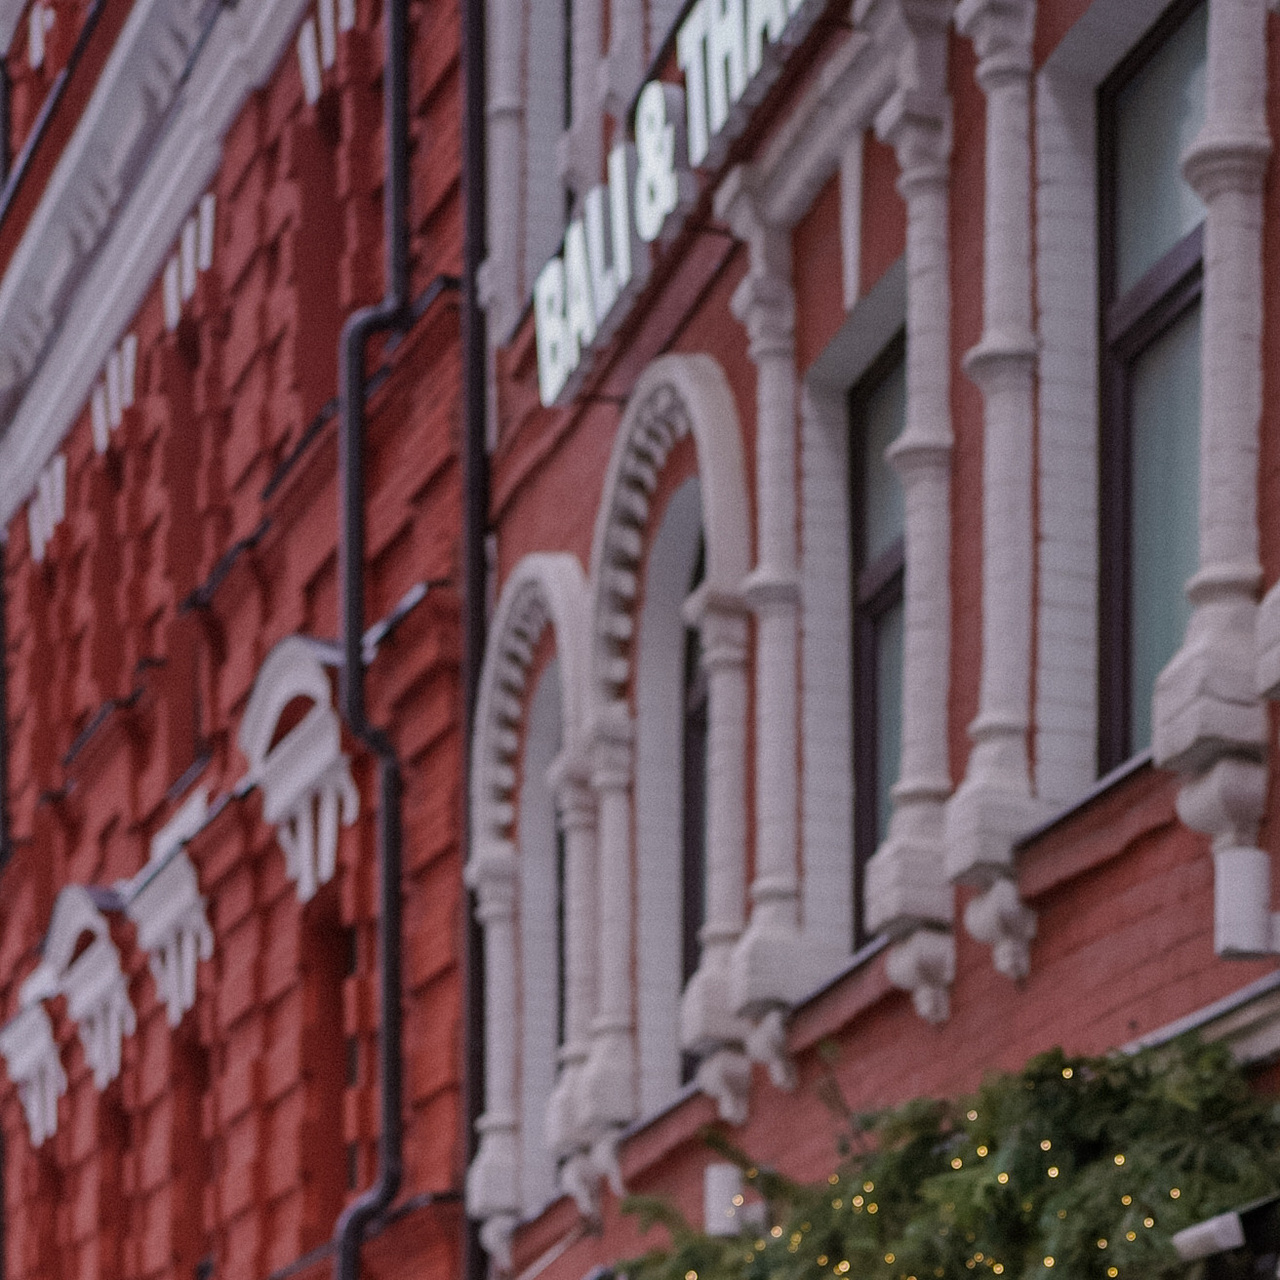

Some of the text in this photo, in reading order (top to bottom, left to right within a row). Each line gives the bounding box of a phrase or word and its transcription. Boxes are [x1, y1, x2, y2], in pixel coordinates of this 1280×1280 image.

[533, 0, 803, 408] BALI & THA
